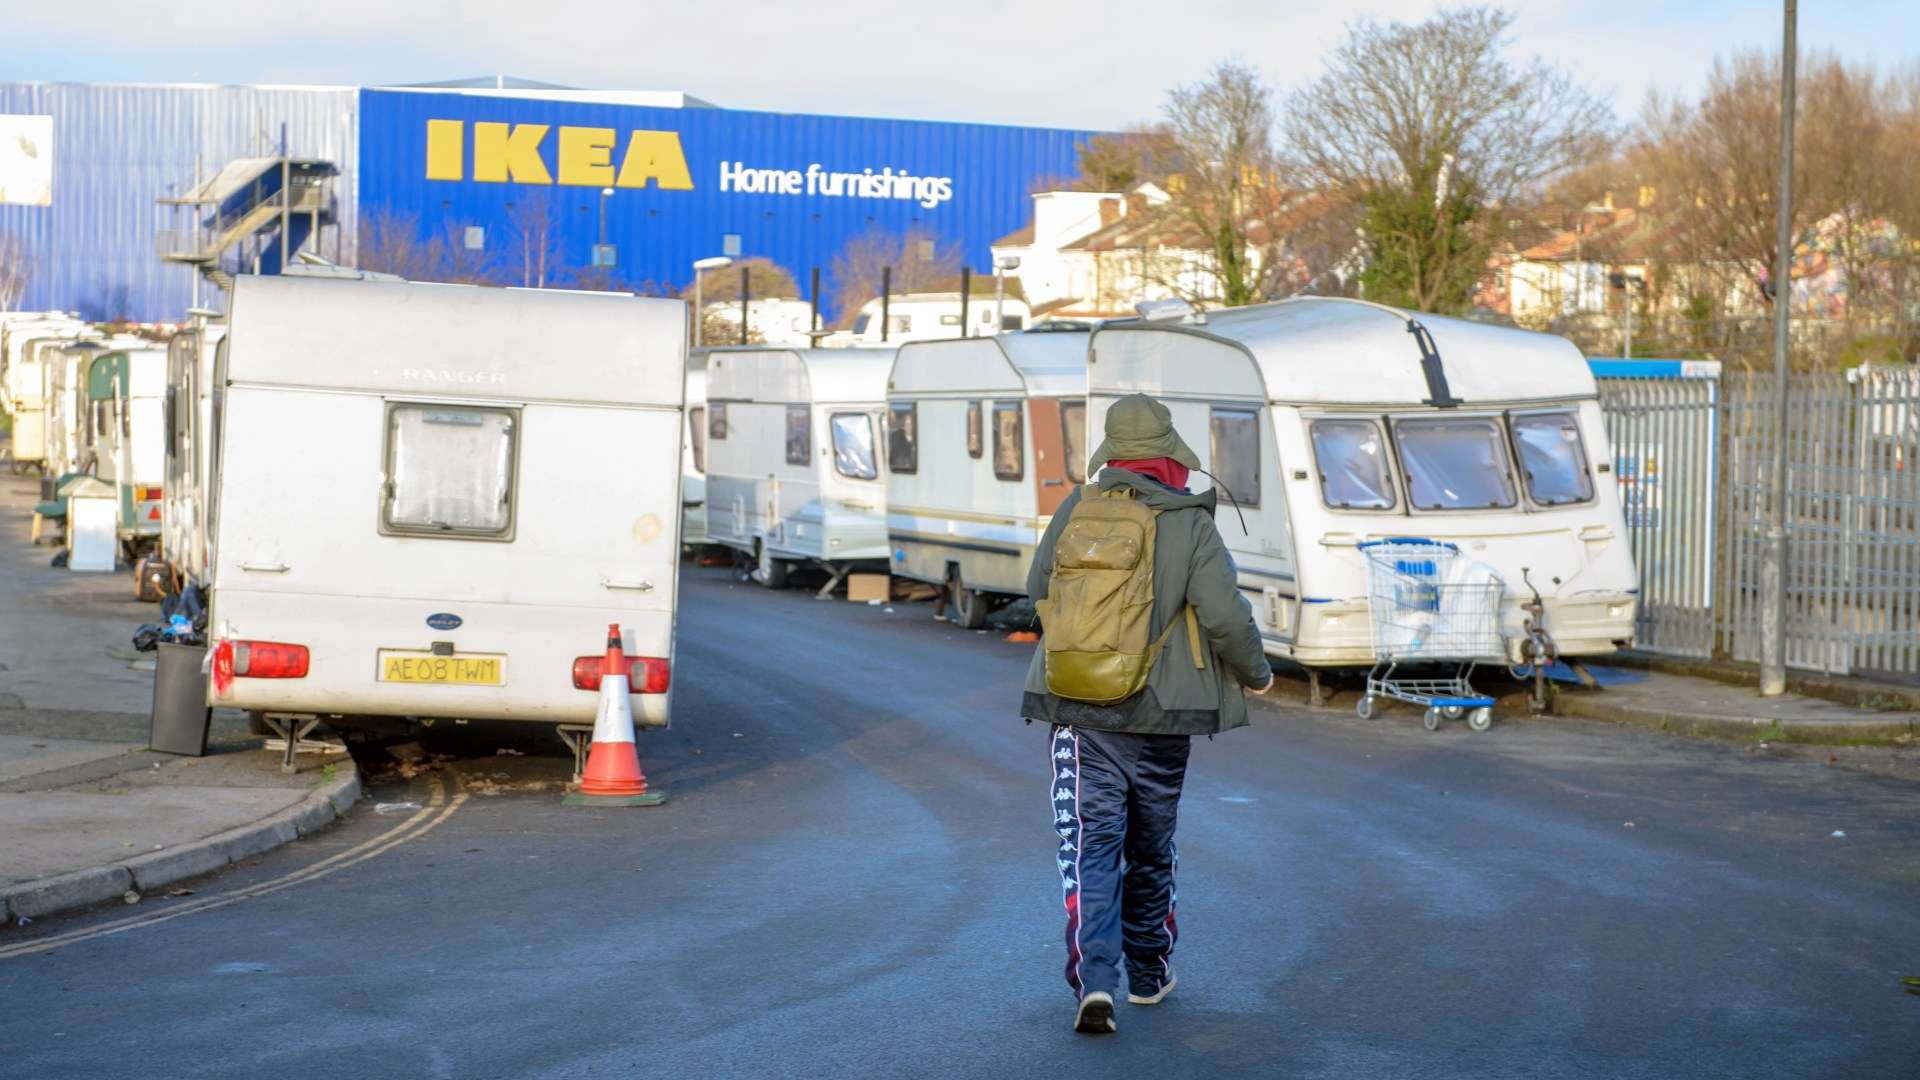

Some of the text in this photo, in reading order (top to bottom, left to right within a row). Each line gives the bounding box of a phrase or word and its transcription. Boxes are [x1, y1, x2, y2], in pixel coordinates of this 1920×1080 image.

[426, 119, 694, 190] IKEA
[720, 161, 952, 208] Home furnishings
[401, 367, 505, 384] RANGER
